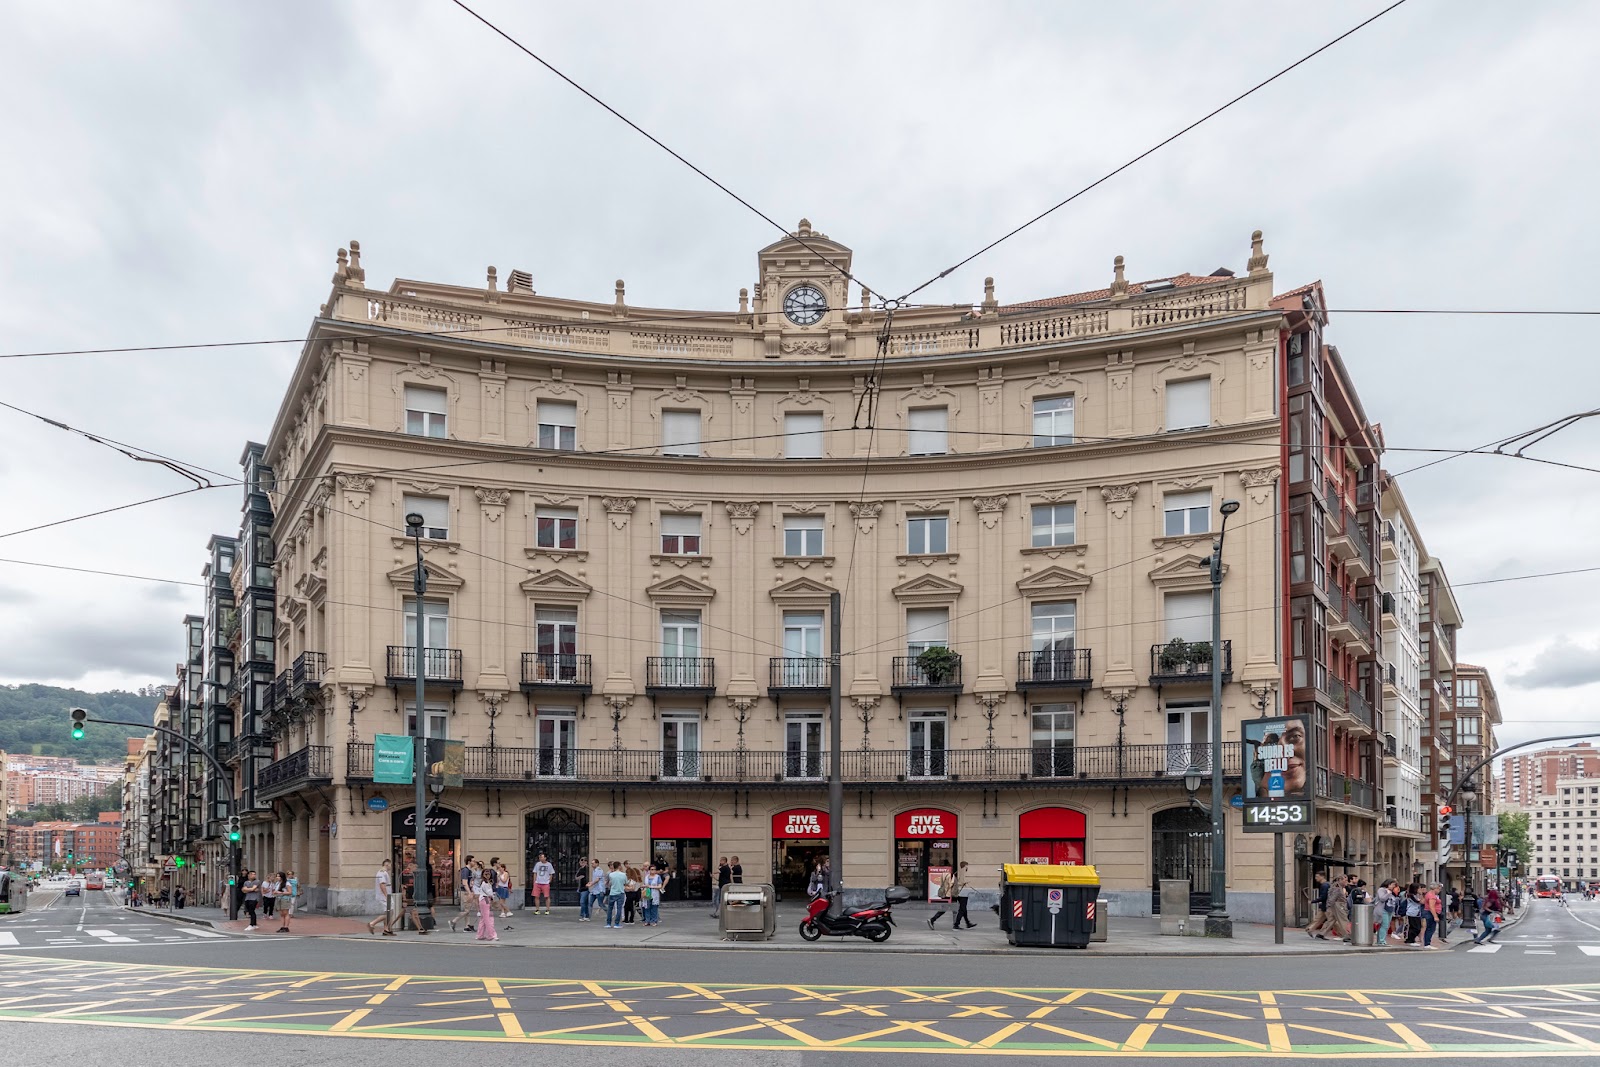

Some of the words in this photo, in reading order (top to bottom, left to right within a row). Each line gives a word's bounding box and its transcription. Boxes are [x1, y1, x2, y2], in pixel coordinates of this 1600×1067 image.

[1257, 745, 1283, 760] SUDAR
[1284, 743, 1294, 758] ES
[1264, 758, 1288, 772] BELLO
[1250, 805, 1303, 822] 14:53
[404, 813, 449, 826] Eam
[788, 815, 817, 824] FIVE
[911, 815, 940, 825] FIVE
[785, 824, 821, 834] GUYS
[907, 825, 944, 834] GUYS
